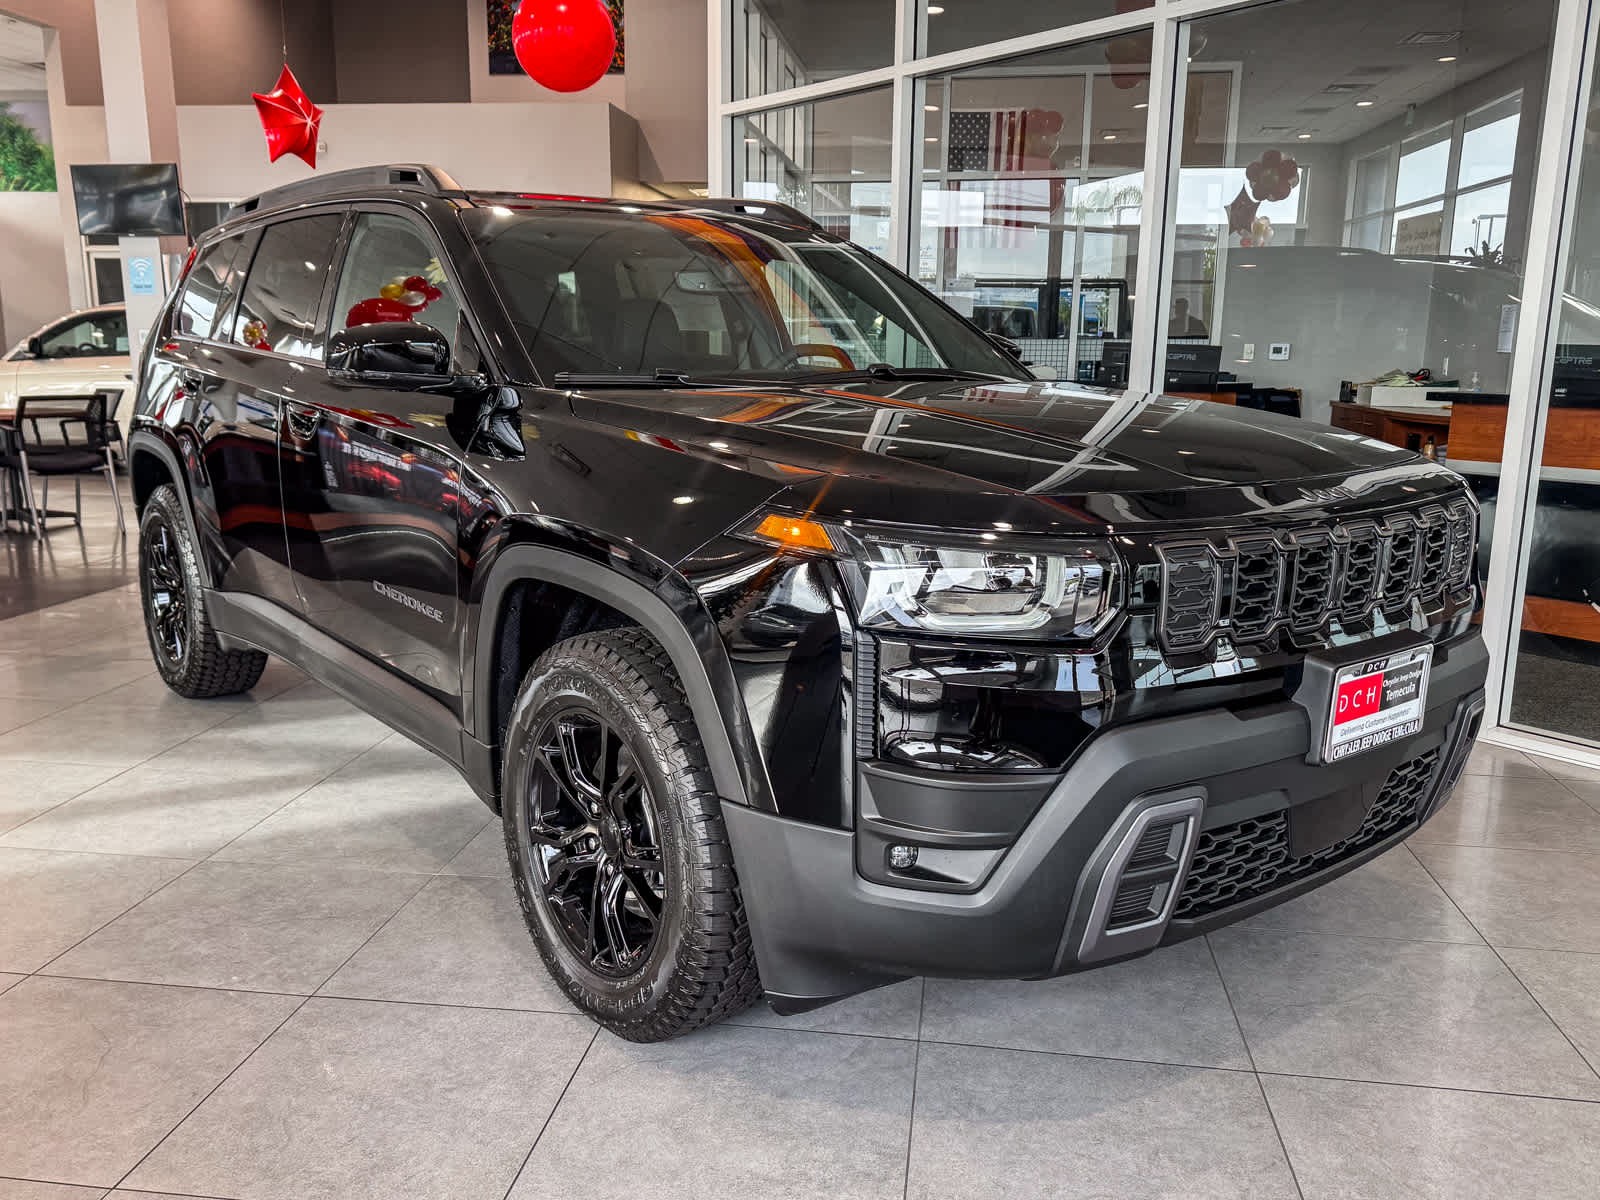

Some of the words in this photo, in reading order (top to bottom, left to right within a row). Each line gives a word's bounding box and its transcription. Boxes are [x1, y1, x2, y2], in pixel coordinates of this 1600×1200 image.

[1167, 352, 1198, 361] CEPTRE
[1297, 484, 1358, 502] Jeep
[372, 580, 444, 623] CHEROKEE
[1386, 681, 1416, 702] Temecula
[1333, 738, 1361, 760] CHRYSLER
[1360, 734, 1373, 750] JEEP
[1373, 728, 1392, 746] DODGE
